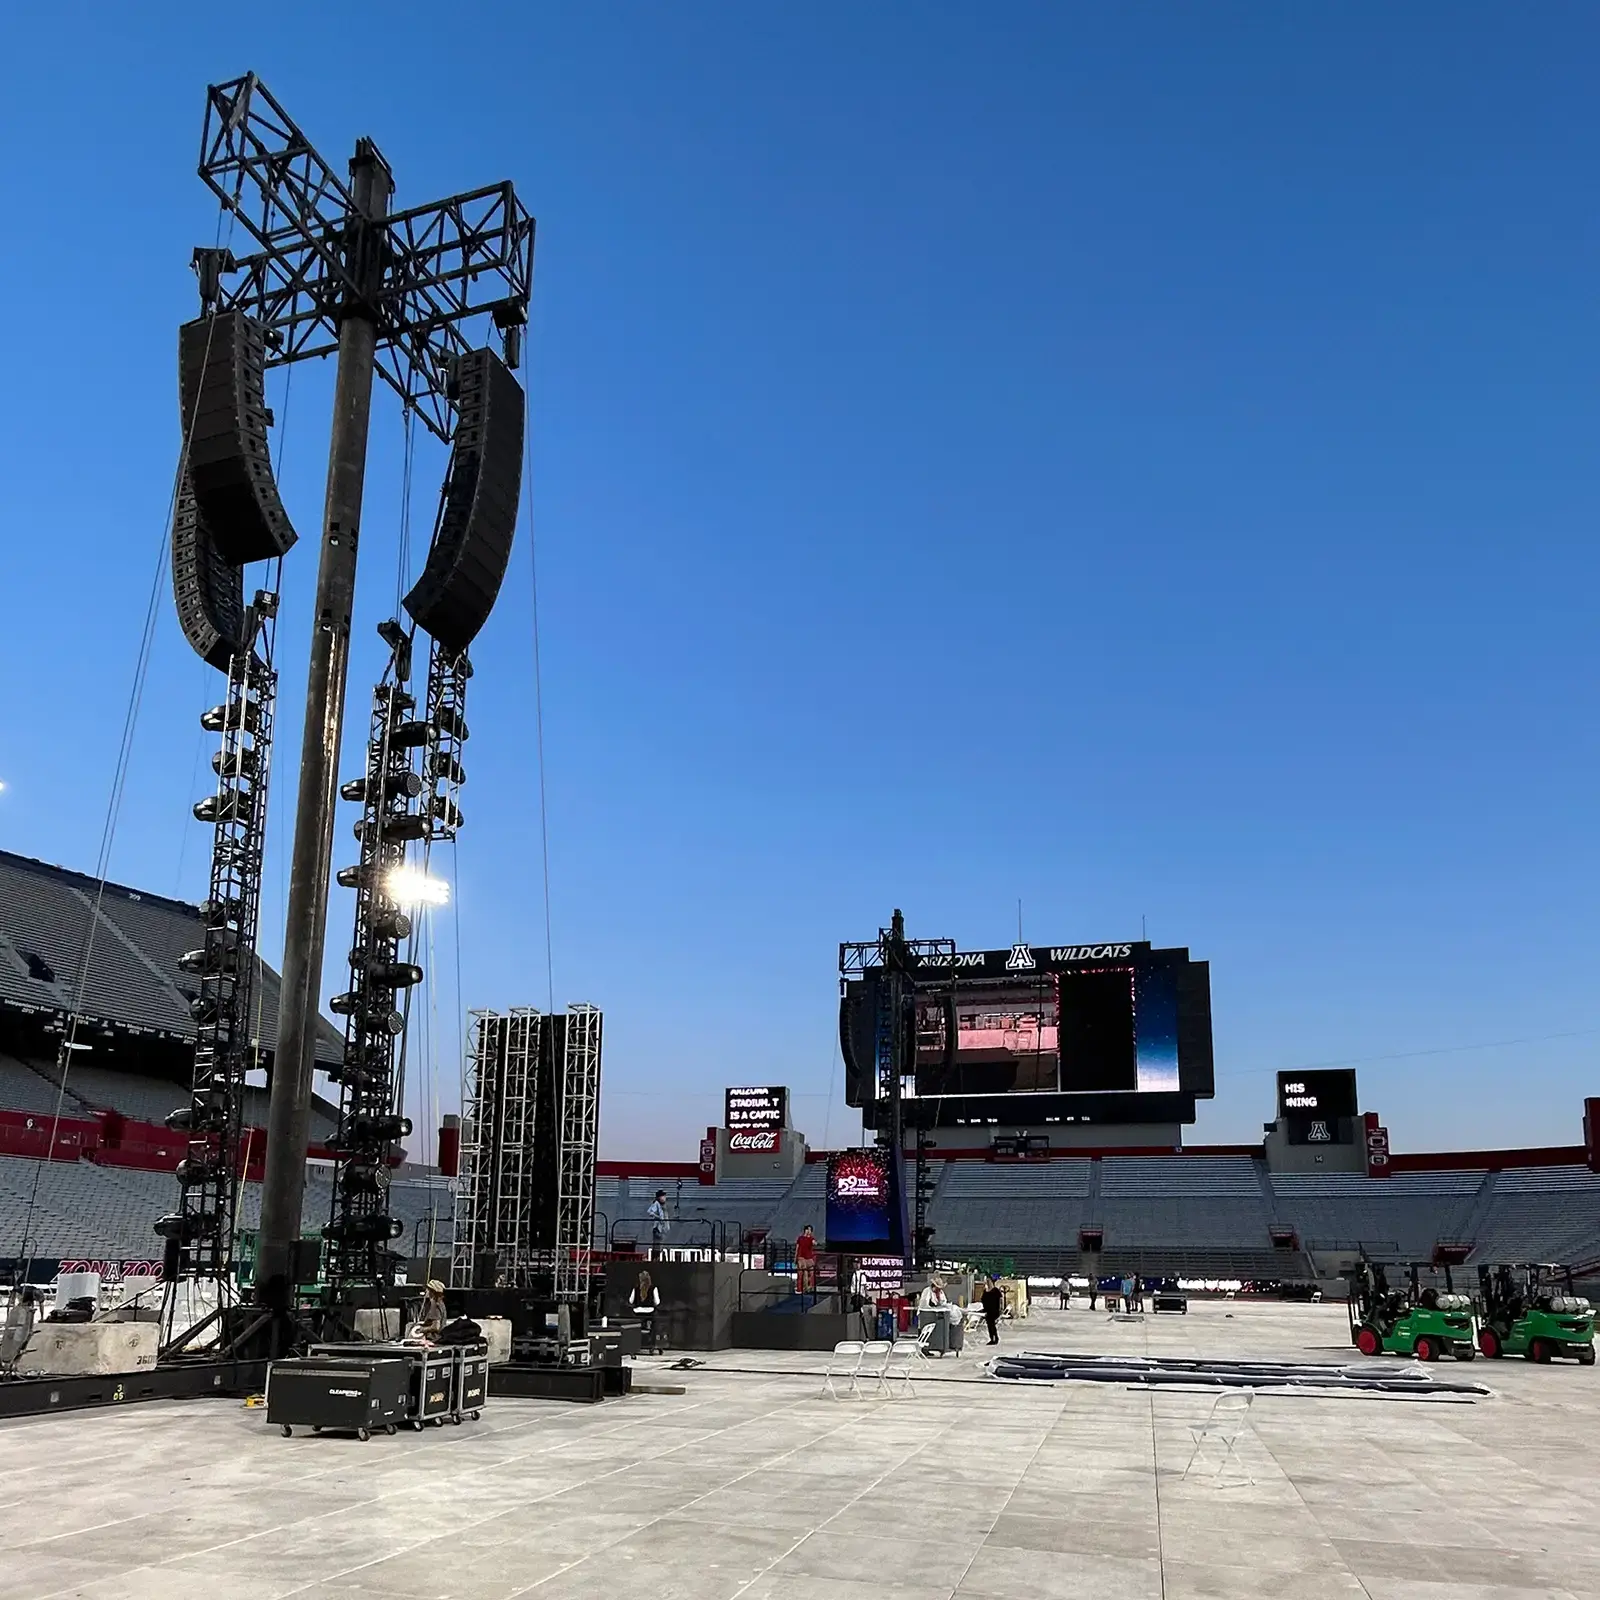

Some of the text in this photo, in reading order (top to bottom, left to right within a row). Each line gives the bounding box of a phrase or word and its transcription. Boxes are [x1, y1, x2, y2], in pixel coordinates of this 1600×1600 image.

[1050, 944, 1132, 962] WILDCATS
[1285, 1083, 1305, 1094] HIS
[729, 1111, 740, 1120] IS
[741, 1111, 748, 1119] A
[26, 1118, 34, 1129] 6
